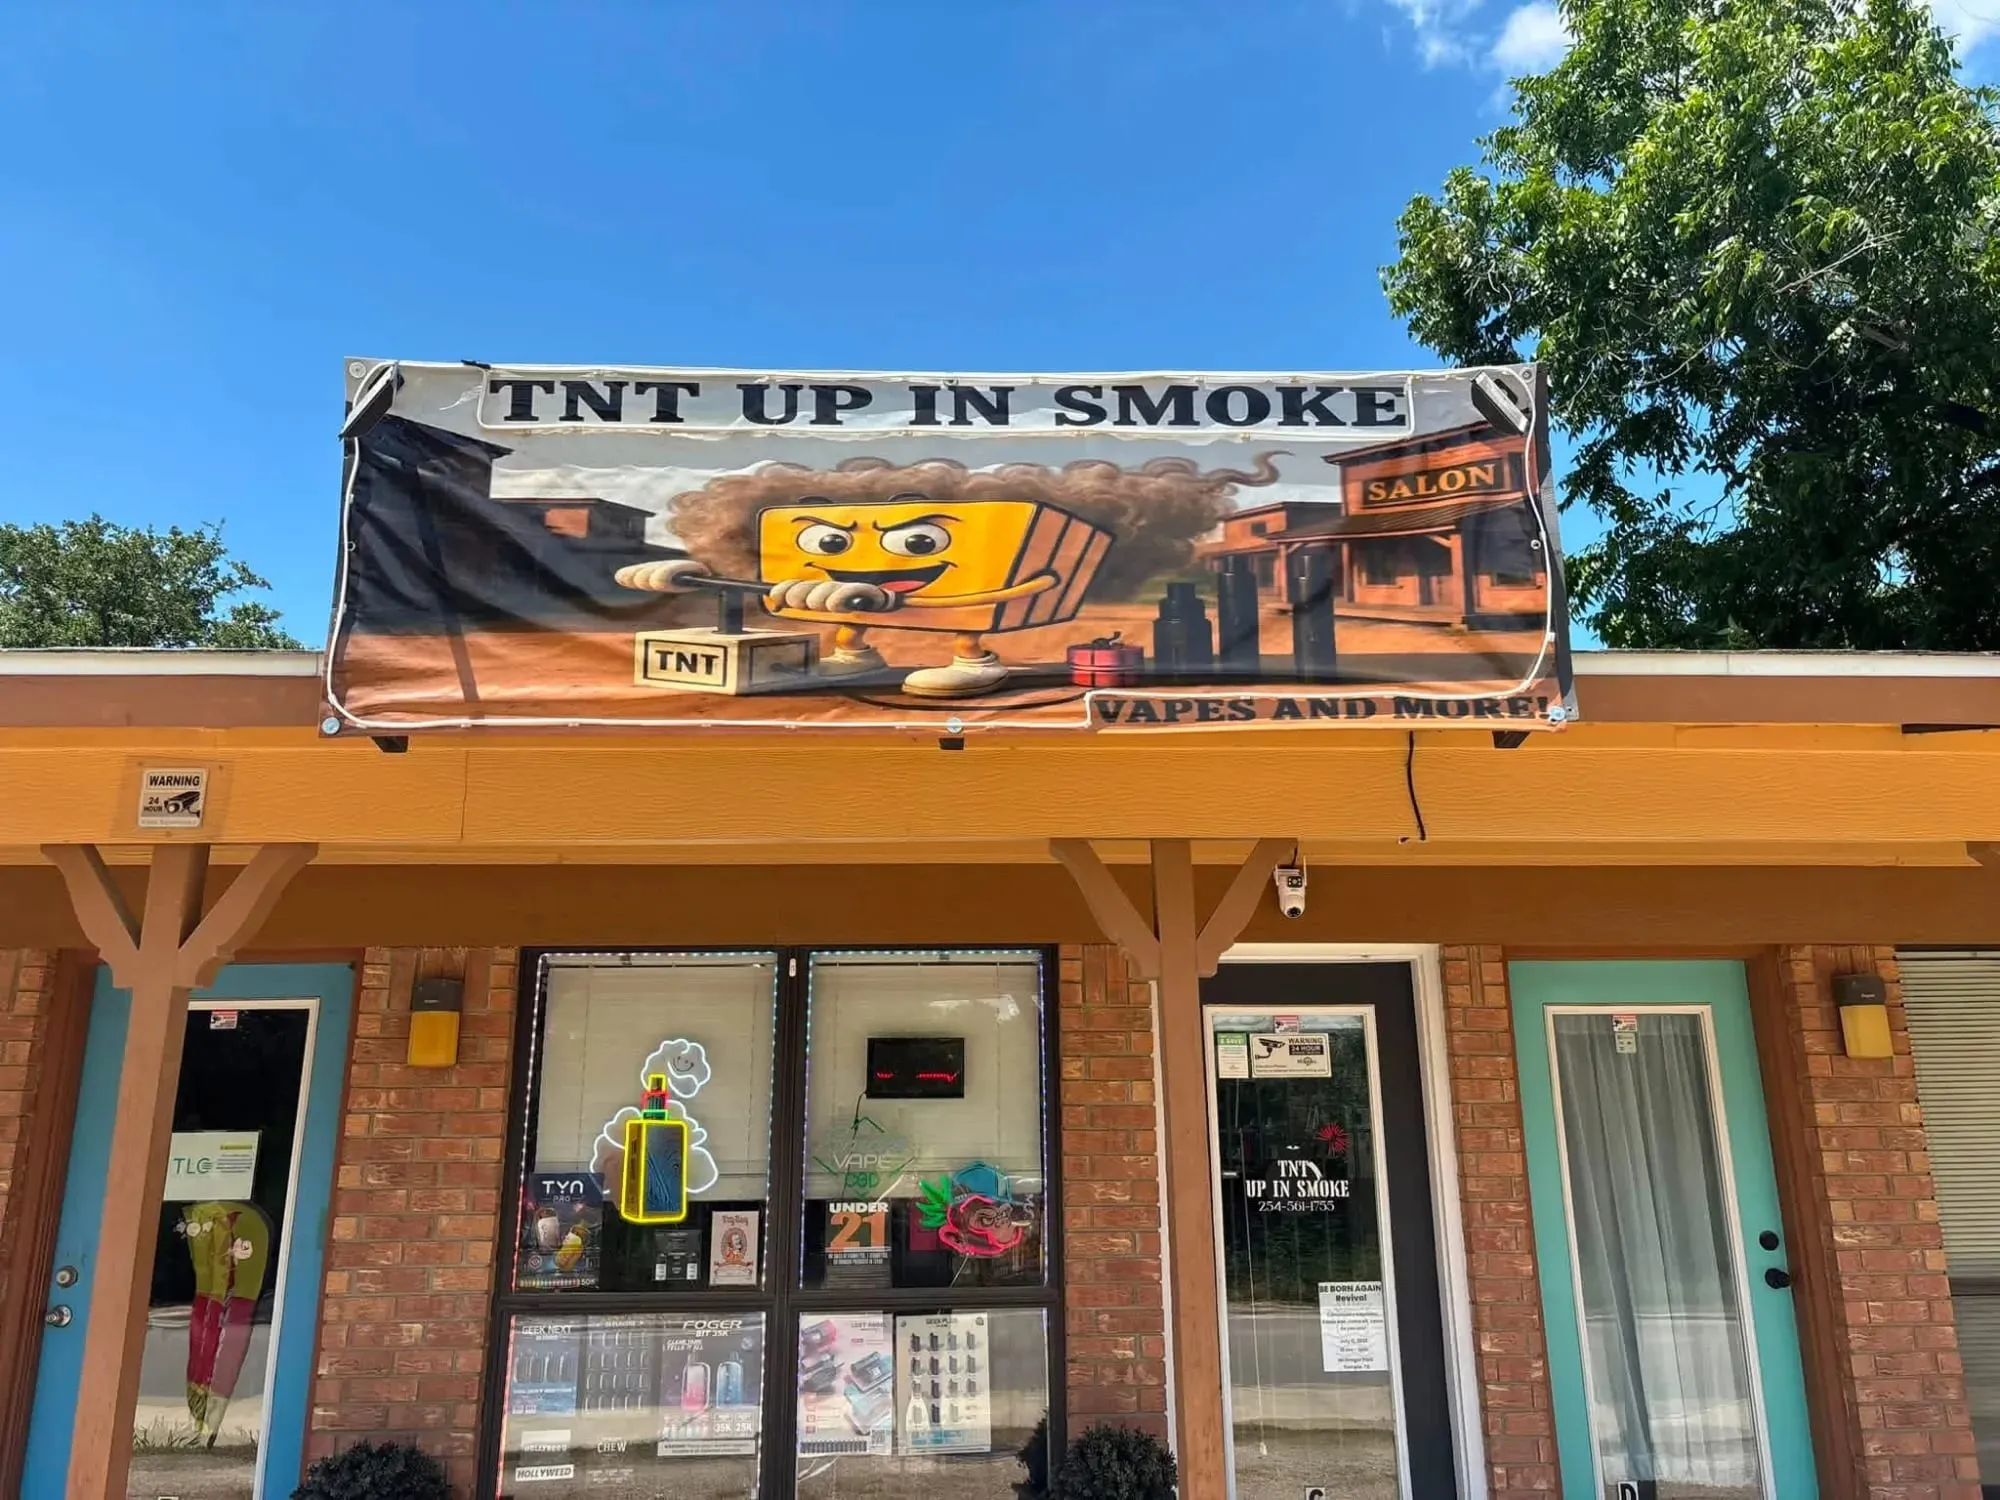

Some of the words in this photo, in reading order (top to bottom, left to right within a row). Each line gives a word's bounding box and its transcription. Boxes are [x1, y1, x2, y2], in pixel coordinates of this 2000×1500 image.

[490, 379, 700, 423] TNT
[736, 382, 873, 425] UP
[908, 385, 1015, 427] IN
[1053, 385, 1407, 427] SMOKE
[1367, 462, 1497, 502] SALON
[654, 649, 719, 677] TNT
[1095, 696, 1256, 724] VAPES
[1270, 696, 1377, 721] AND
[1392, 694, 1550, 720] MORE!
[149, 775, 200, 787] WARNING
[148, 796, 160, 805] 24
[832, 1153, 892, 1170] VAPE
[1277, 1160, 1308, 1178] TNT
[1246, 1180, 1267, 1198] UP
[1273, 1180, 1290, 1198] IN
[1297, 1180, 1350, 1198] SMOKE
[829, 1202, 889, 1214] UNDER
[830, 1212, 886, 1253] 21
[1355, 1284, 1381, 1292] AGAIN
[1335, 1294, 1367, 1302] Revival
[683, 1320, 742, 1330] FOGER
[596, 1440, 628, 1453] CHEW
[517, 1467, 572, 1479] HOLLYWEED
